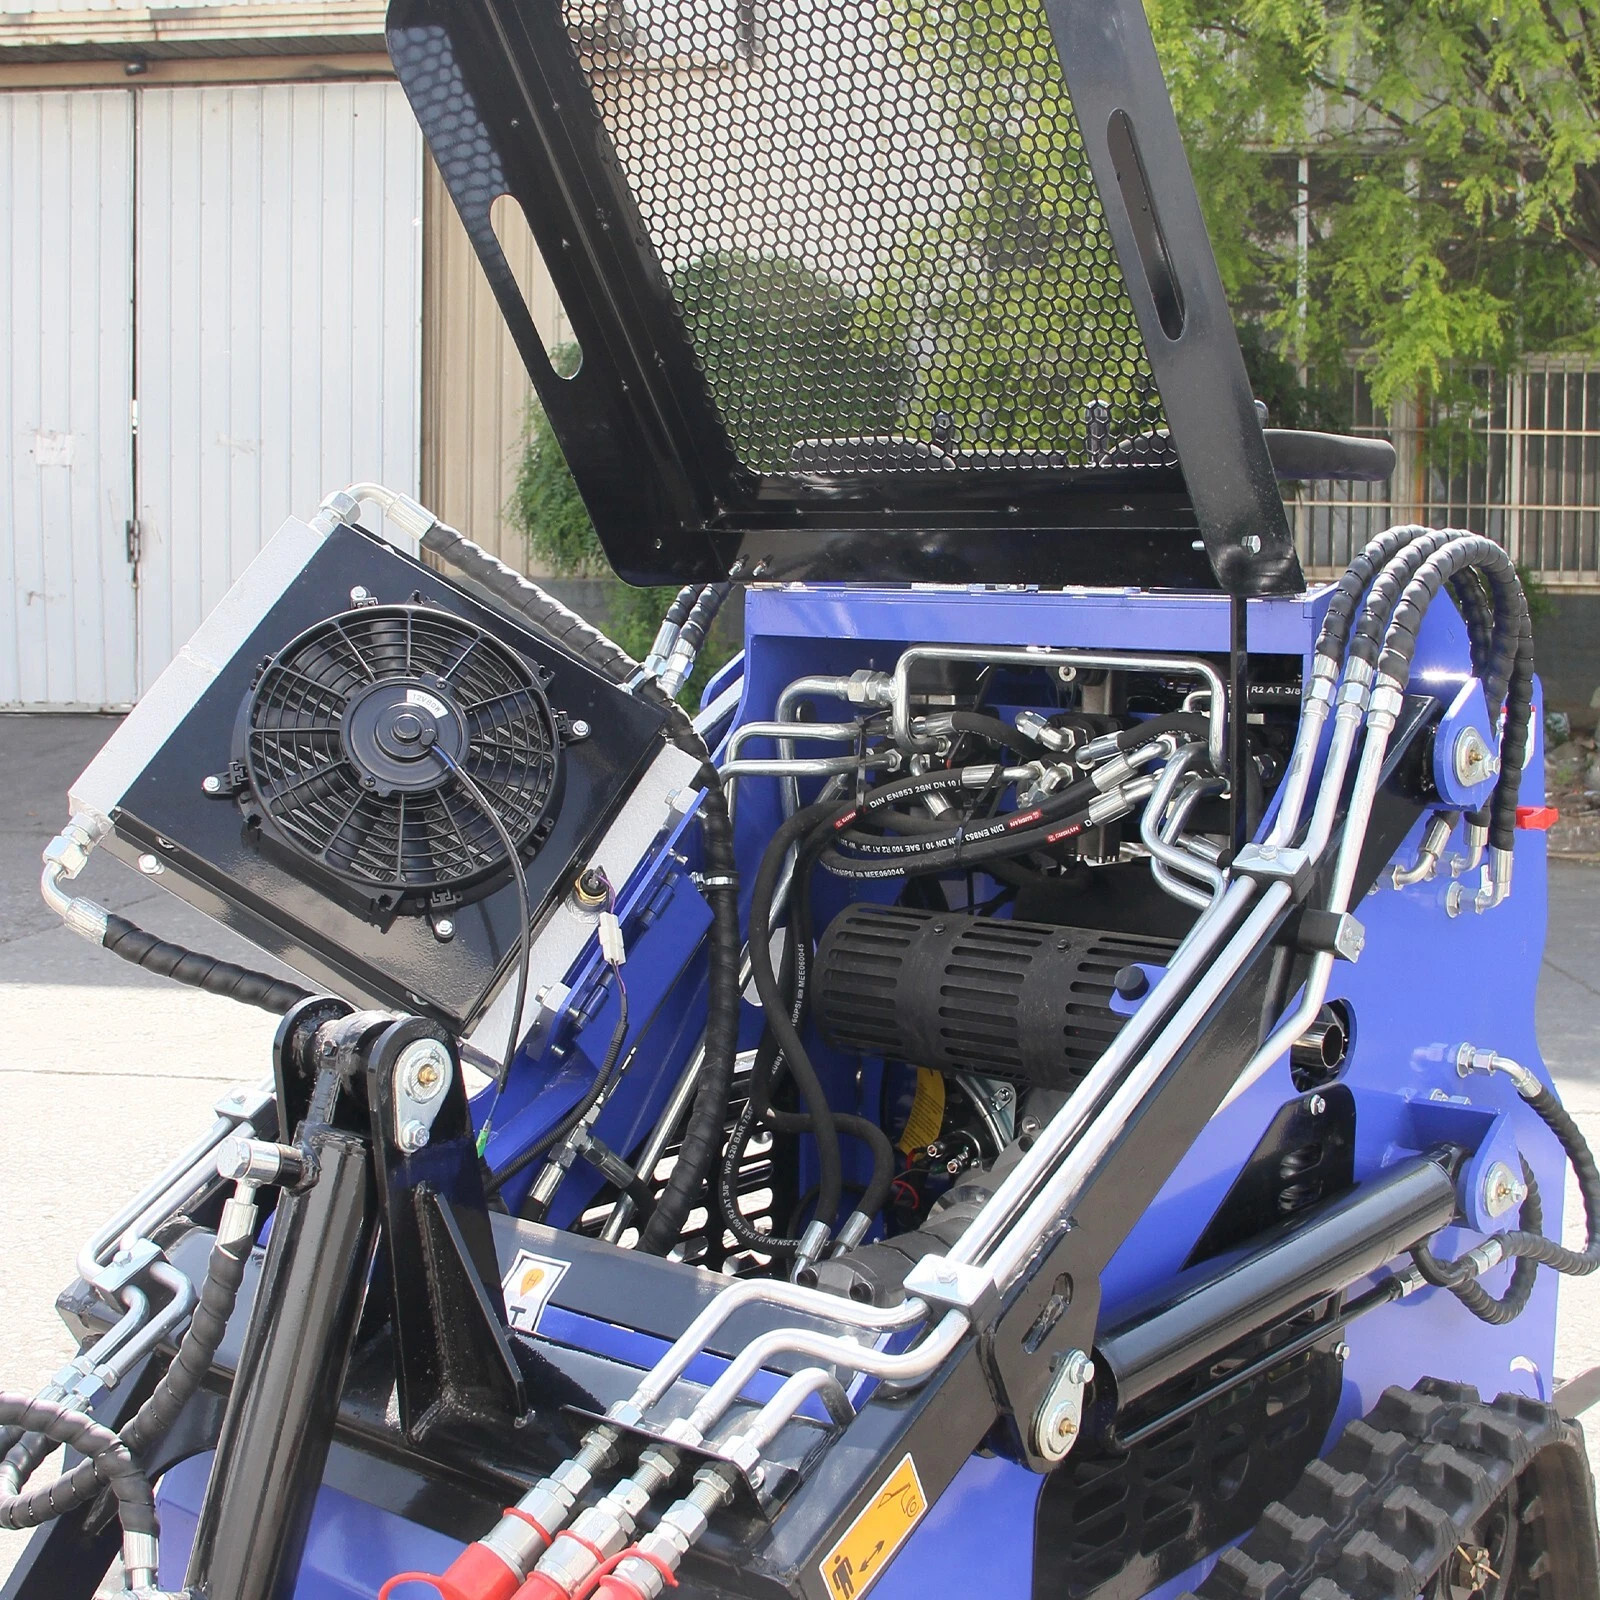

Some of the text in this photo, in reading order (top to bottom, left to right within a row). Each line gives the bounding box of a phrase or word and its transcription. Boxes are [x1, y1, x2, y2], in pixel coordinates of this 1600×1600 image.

[1251, 686, 1264, 694] R2
[1266, 686, 1282, 694] AT
[869, 797, 886, 808] DIN
[886, 787, 914, 801] EN853
[914, 784, 932, 793] 2SN
[933, 780, 946, 789] DN
[991, 823, 1005, 835] DIN
[965, 830, 990, 842] EN853
[872, 845, 881, 853] AT
[882, 846, 892, 854] R2
[892, 845, 904, 853] 100
[906, 843, 920, 852] SAE
[925, 842, 935, 850] 10
[864, 867, 905, 878] MEE060045
[797, 943, 806, 988] MEE060045
[733, 1125, 746, 1144] BAR
[728, 1144, 738, 1159] 520
[724, 1160, 733, 1174] WP
[723, 1198, 732, 1208] AT
[727, 1210, 737, 1220] R2
[732, 1219, 743, 1230] 100
[741, 1227, 756, 1239] SAE
